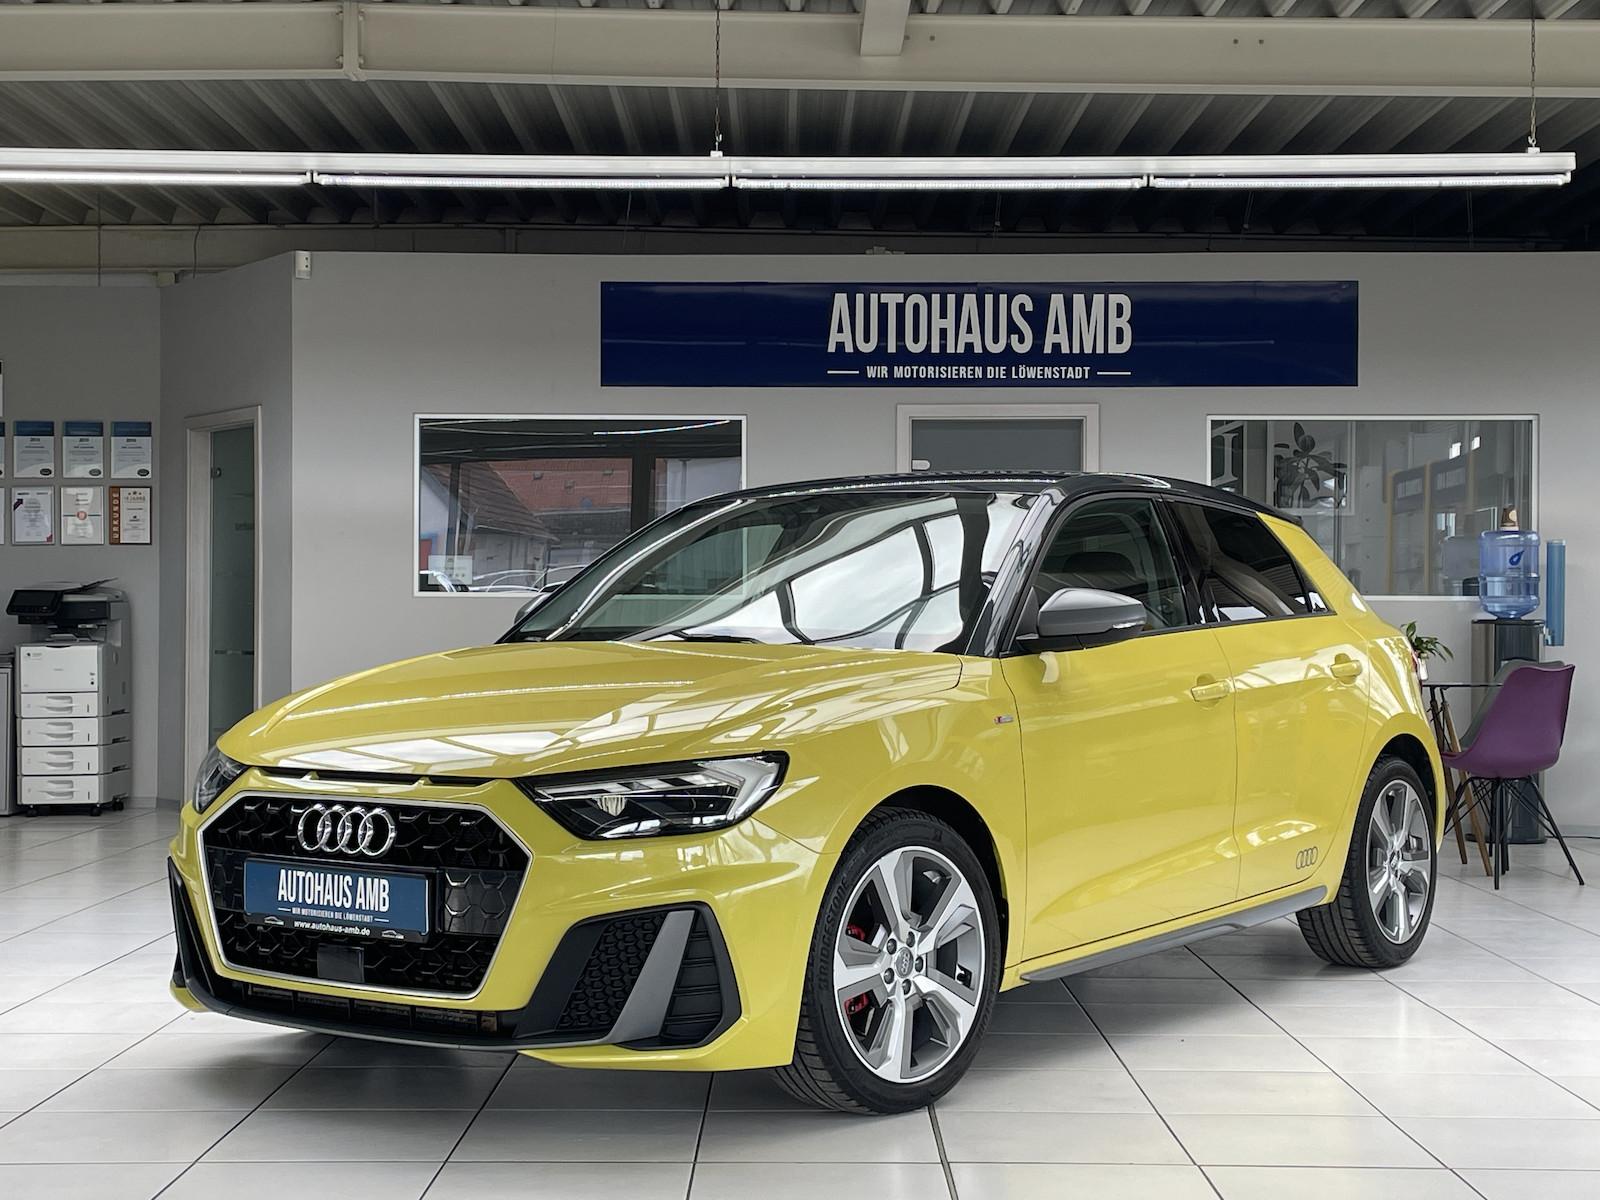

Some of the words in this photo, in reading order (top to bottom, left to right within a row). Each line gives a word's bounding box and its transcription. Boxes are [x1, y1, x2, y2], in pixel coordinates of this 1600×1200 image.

[827, 293, 1034, 354] AUTOHAUS
[1043, 293, 1132, 354] AMB
[866, 365, 889, 379] WIR
[893, 365, 983, 379] MOTORISIEREN
[987, 366, 1008, 379] DIE
[1011, 364, 1091, 380] LÖWENSTADT
[278, 869, 352, 908] AUTOHAUS
[355, 877, 389, 912] AMB
[294, 921, 371, 936] www.autohaus-amb.de
